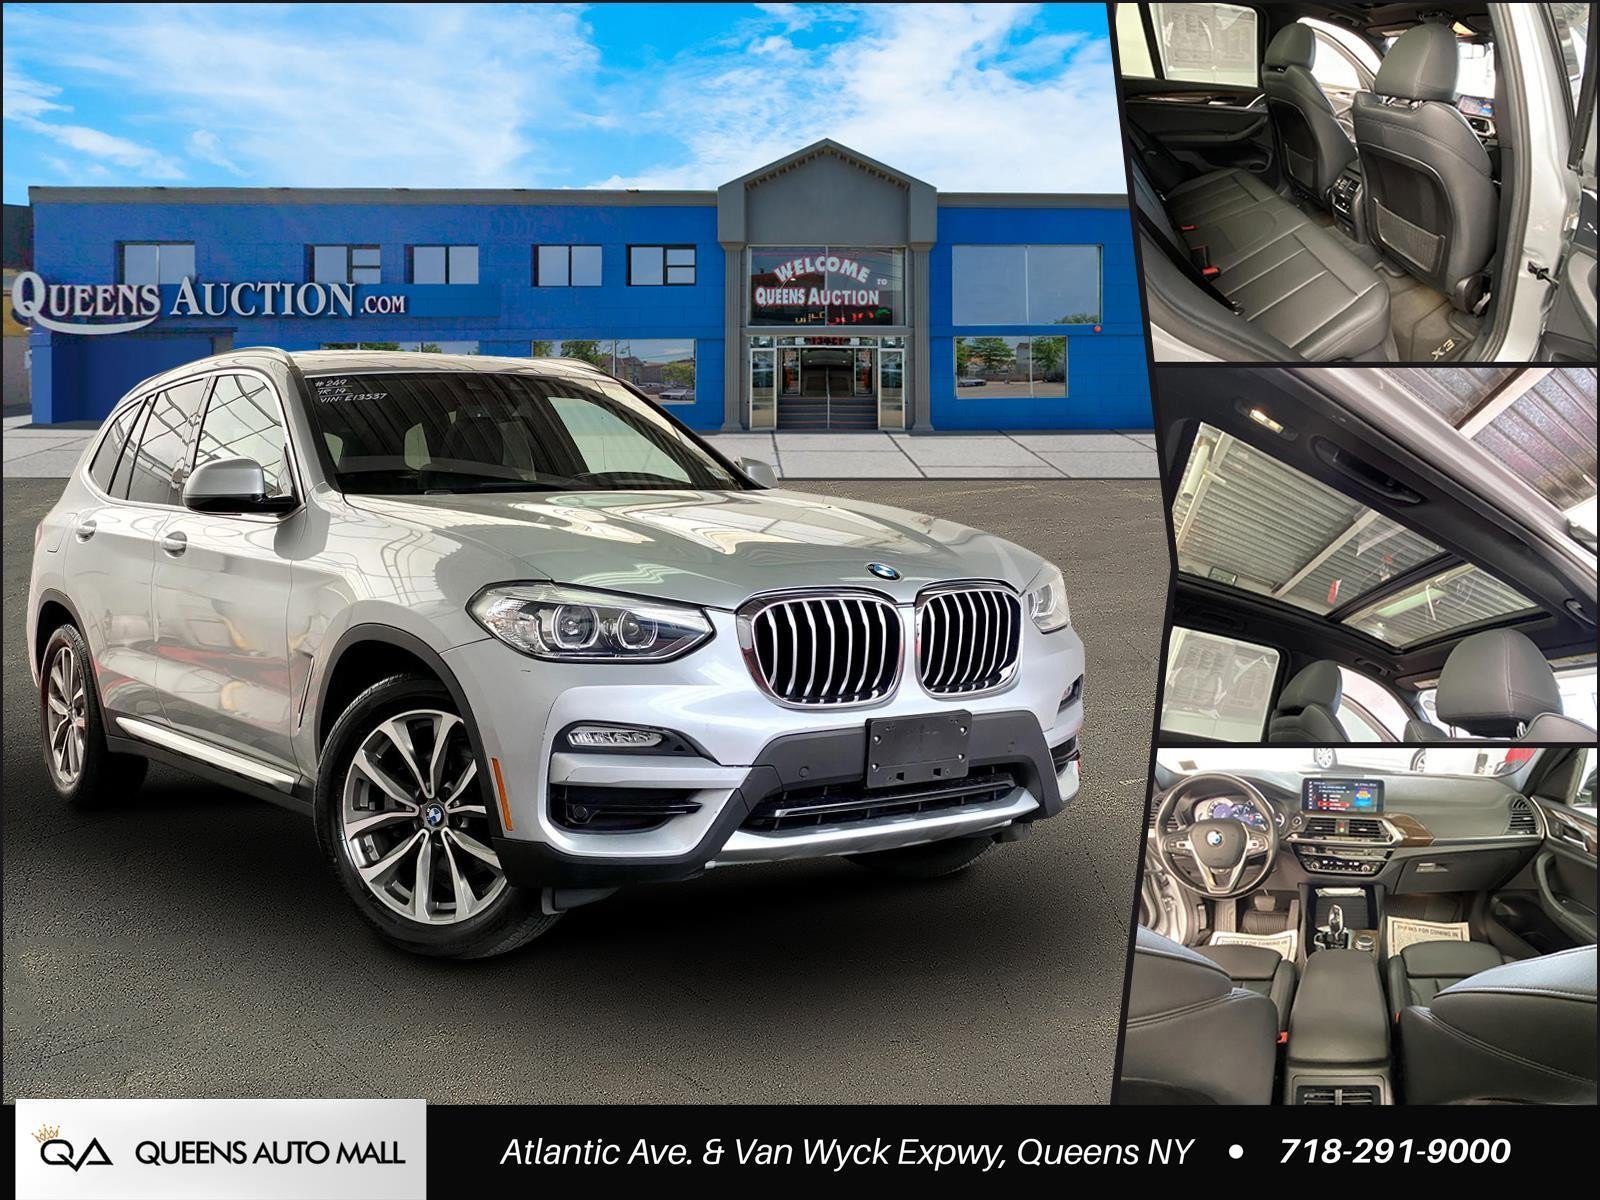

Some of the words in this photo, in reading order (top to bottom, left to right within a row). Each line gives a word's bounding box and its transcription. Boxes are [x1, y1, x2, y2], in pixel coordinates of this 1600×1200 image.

[774, 255, 871, 284] WELCOME
[11, 271, 161, 335] QUEENS
[755, 287, 805, 306] QUEENS
[807, 287, 879, 305] AUCTION
